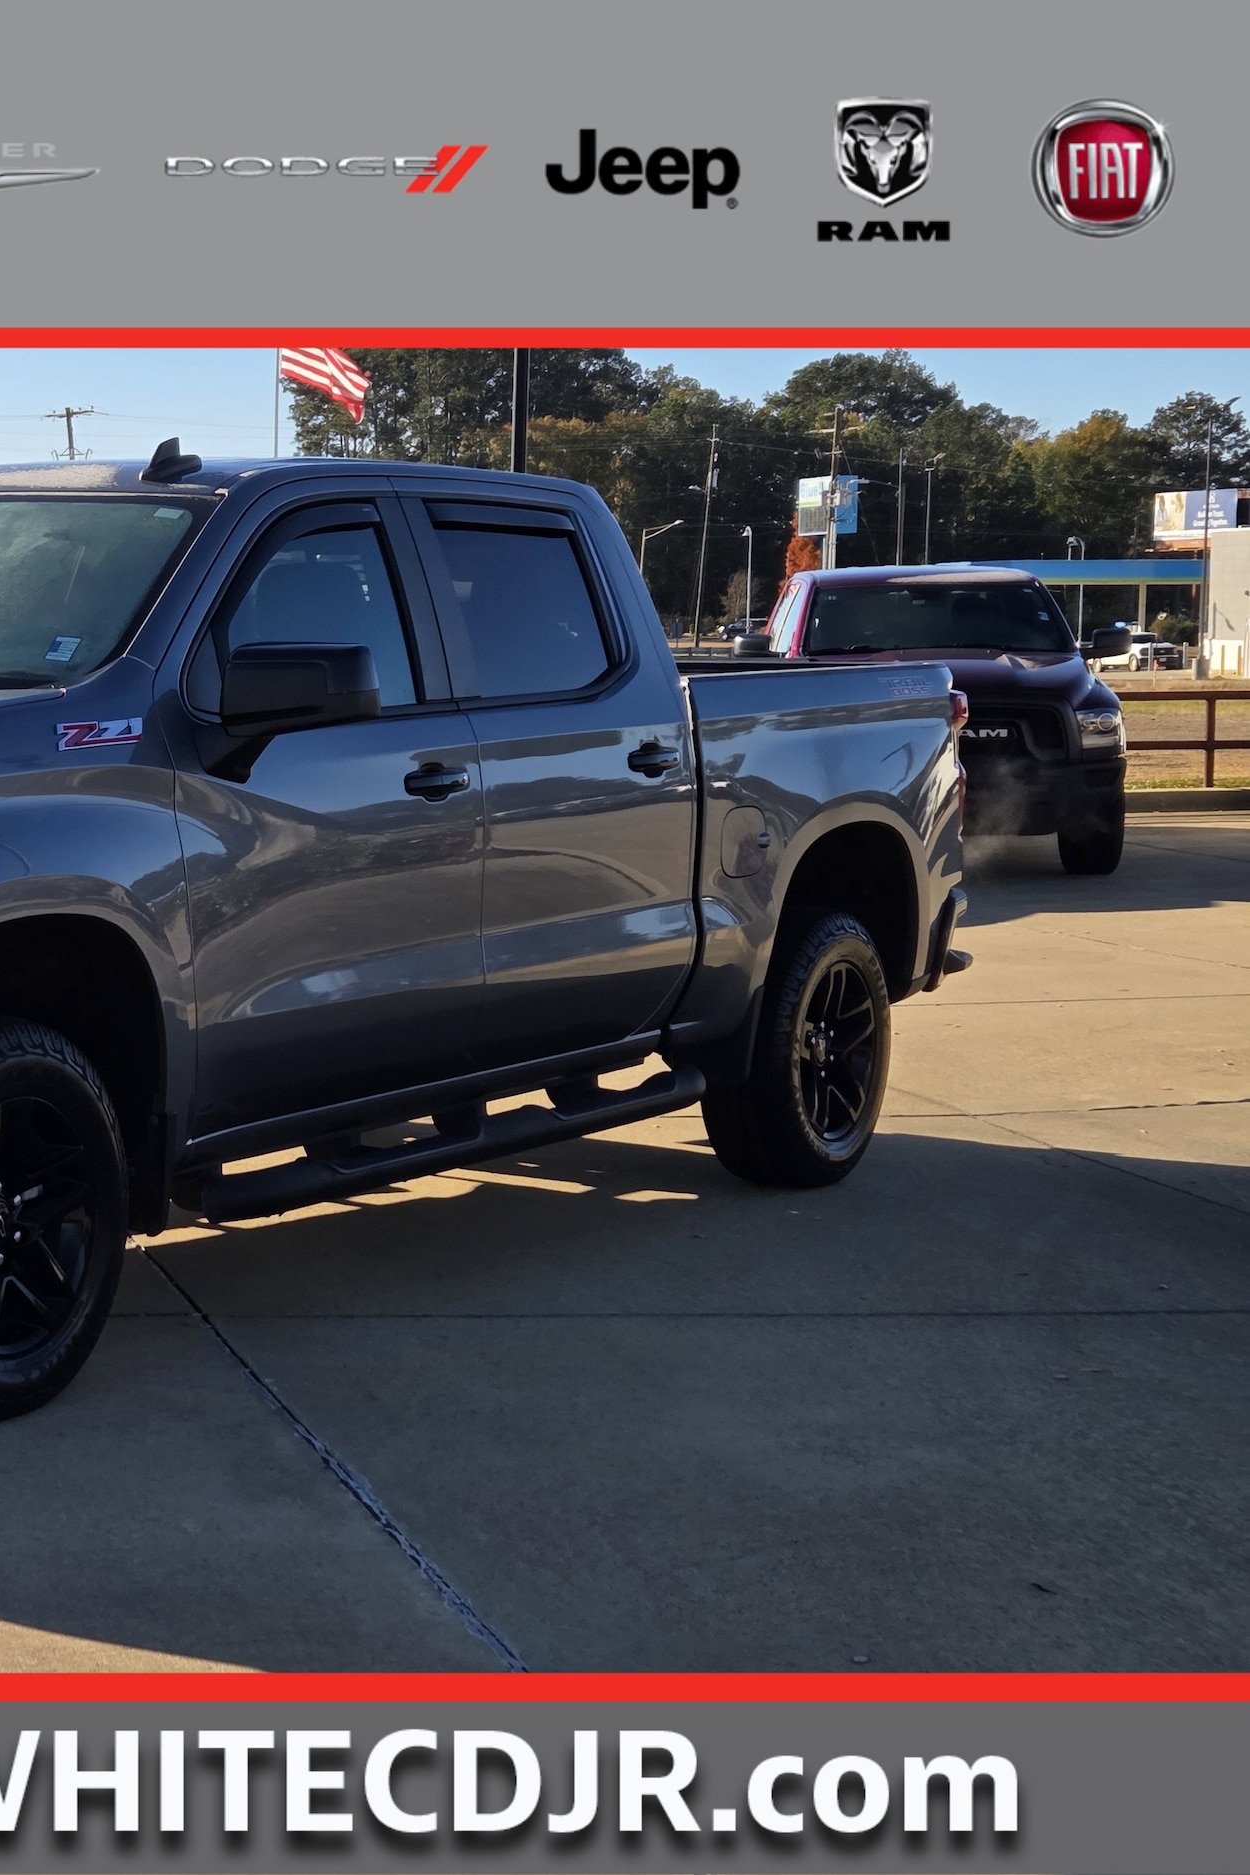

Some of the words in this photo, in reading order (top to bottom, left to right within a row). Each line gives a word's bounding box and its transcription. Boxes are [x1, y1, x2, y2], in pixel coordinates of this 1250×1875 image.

[879, 677, 934, 688] TRAIL
[892, 687, 931, 697] BOSS
[56, 717, 143, 751] Z71
[958, 728, 1008, 738] AM
